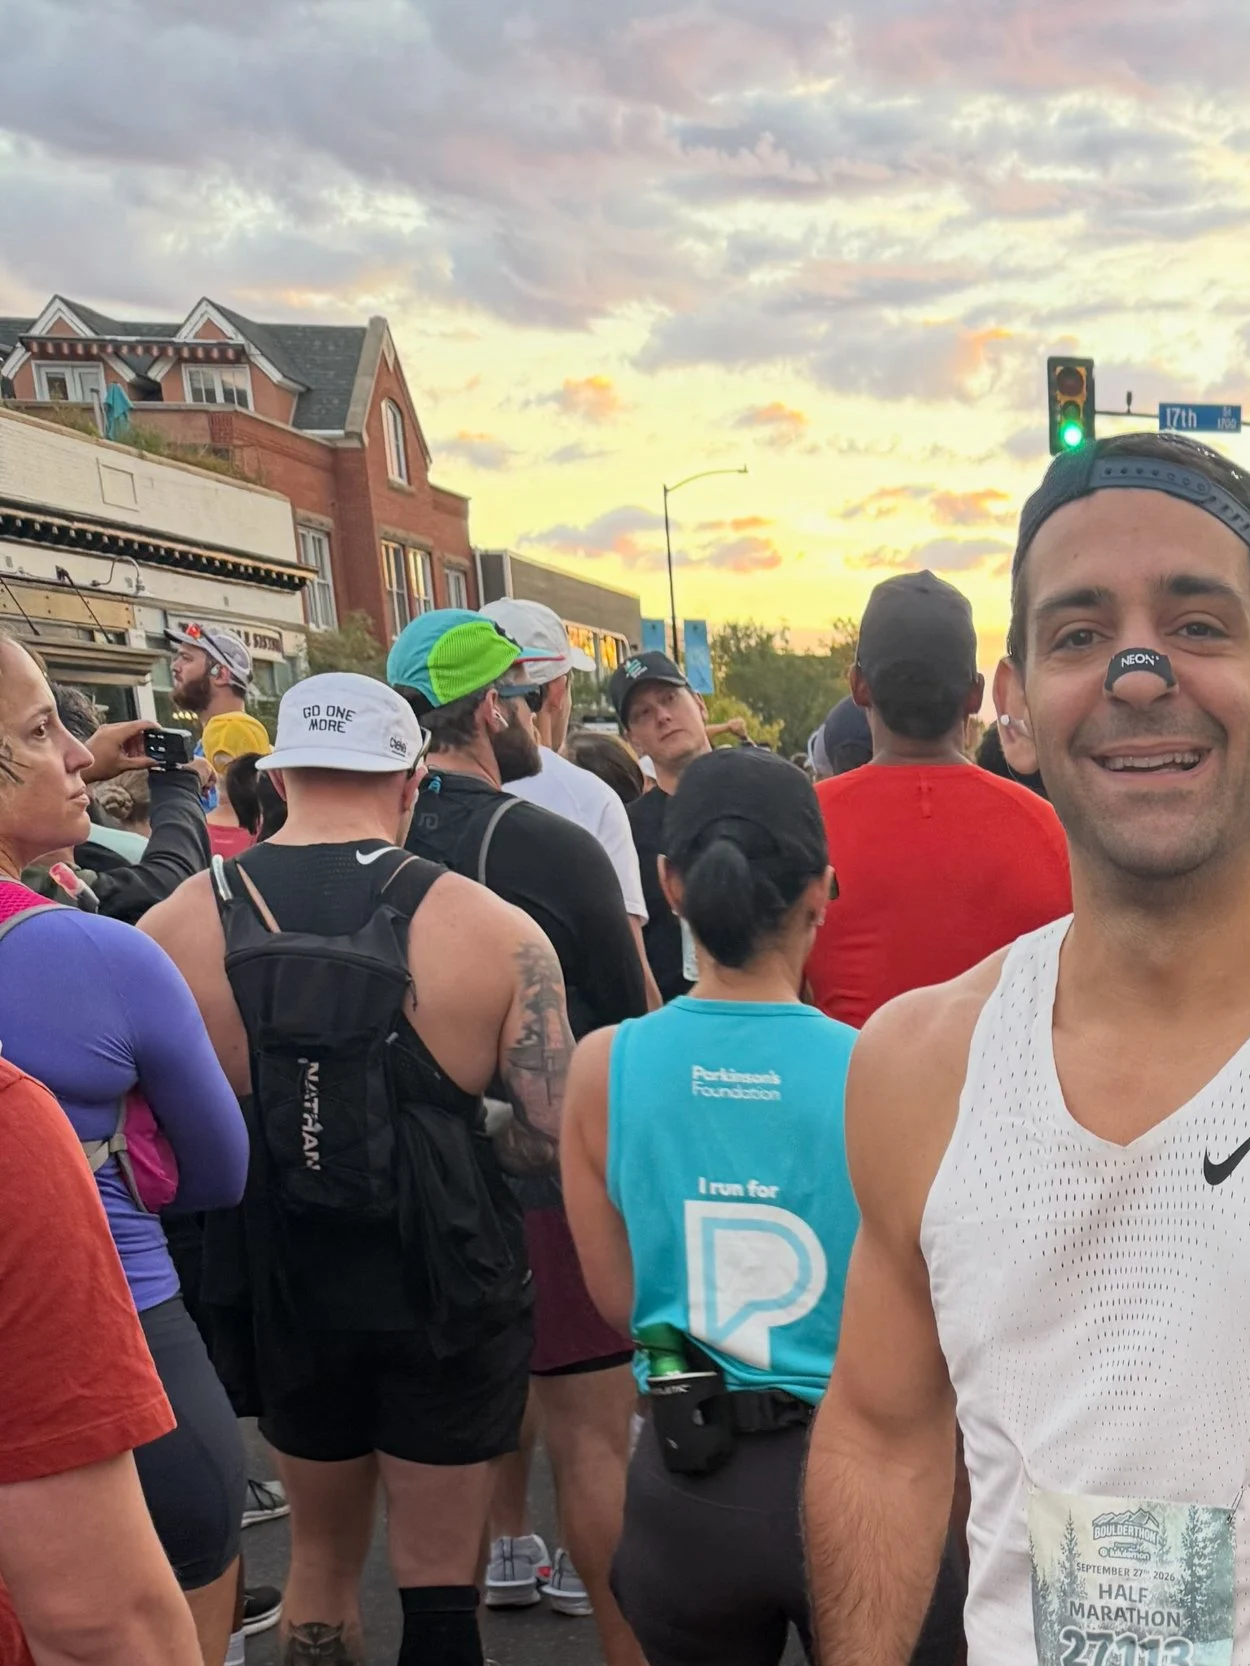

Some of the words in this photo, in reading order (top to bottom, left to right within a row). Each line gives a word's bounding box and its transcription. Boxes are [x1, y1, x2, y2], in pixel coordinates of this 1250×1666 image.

[1166, 407, 1197, 429] 17th
[1121, 653, 1155, 668] NEON
[303, 705, 321, 719] GO
[326, 705, 356, 722] ONE
[308, 719, 347, 734] MORE
[691, 1064, 781, 1085] Parkinson's
[691, 1081, 781, 1101] Foundation
[302, 1062, 320, 1170] NATHAN
[698, 1176, 707, 1195] I
[709, 1182, 745, 1196] run
[747, 1179, 780, 1198] for
[1093, 1524, 1158, 1545] BOULDERTHON
[1076, 1562, 1130, 1577] SEPTEMBER
[1153, 1570, 1176, 1582] 2026
[1098, 1583, 1149, 1603] HALF
[1069, 1601, 1181, 1627] MARATHON
